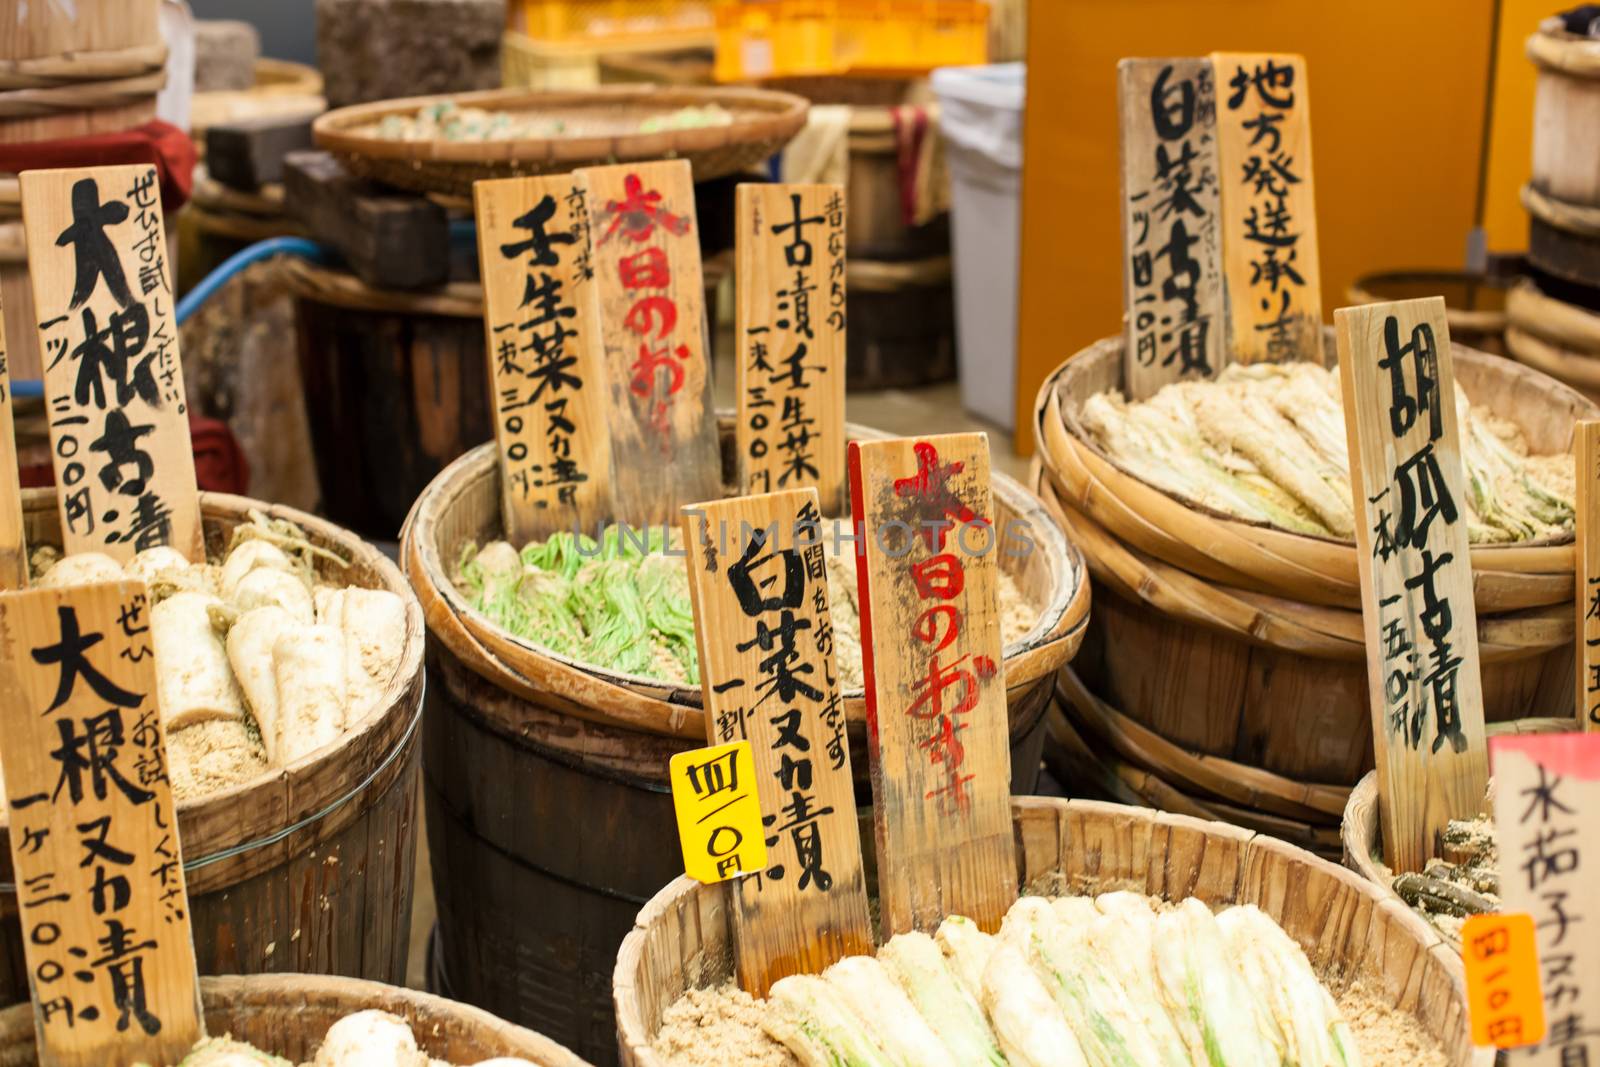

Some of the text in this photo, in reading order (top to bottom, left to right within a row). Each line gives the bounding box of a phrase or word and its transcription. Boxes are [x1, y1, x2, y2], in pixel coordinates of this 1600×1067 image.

[54, 177, 174, 553] 大根古漬
[768, 194, 828, 488] 古漬壬生菜
[1151, 65, 1214, 377] 白菜古漬
[1378, 316, 1467, 755] 胡瓜古漬
